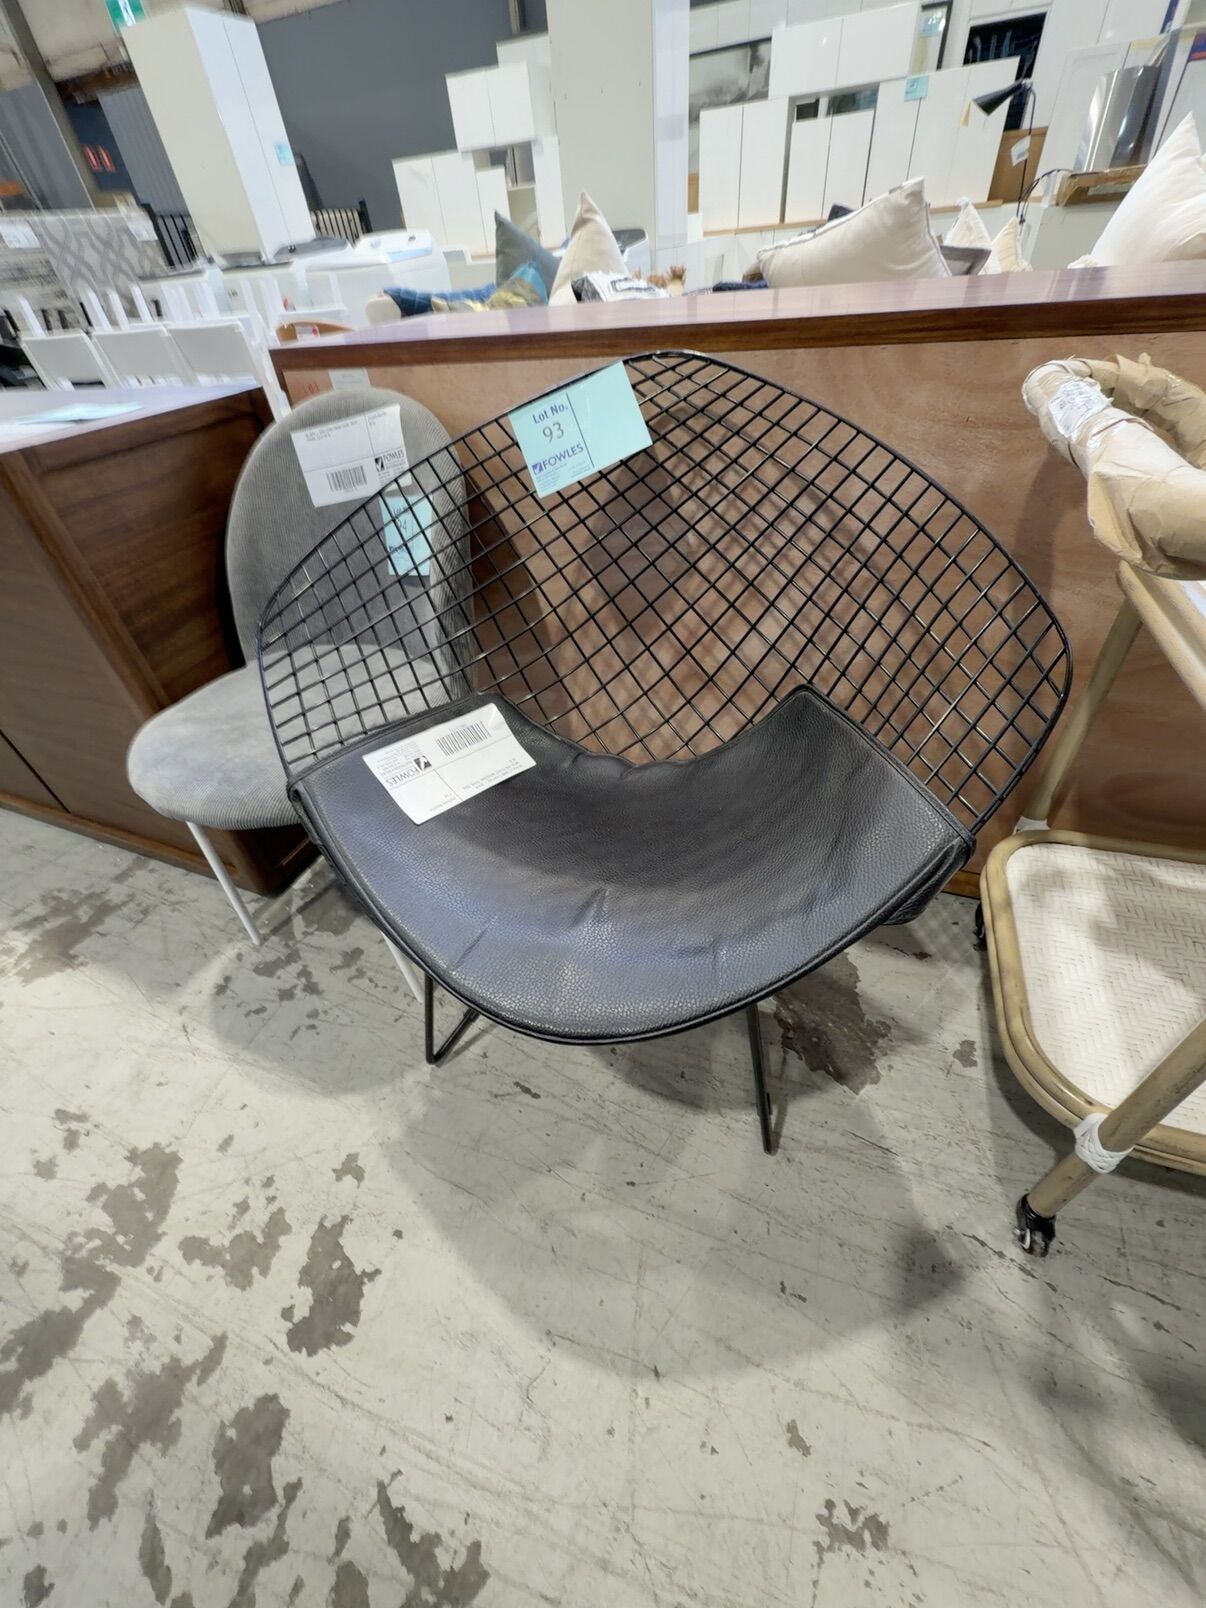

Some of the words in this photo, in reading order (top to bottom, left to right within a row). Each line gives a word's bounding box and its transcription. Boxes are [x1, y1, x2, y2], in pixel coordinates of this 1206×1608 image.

[532, 409, 549, 424] Lot
[550, 401, 568, 416] No.
[542, 422, 564, 443] 93
[542, 443, 584, 470] FOWLES
[386, 766, 419, 786] FOWLES
